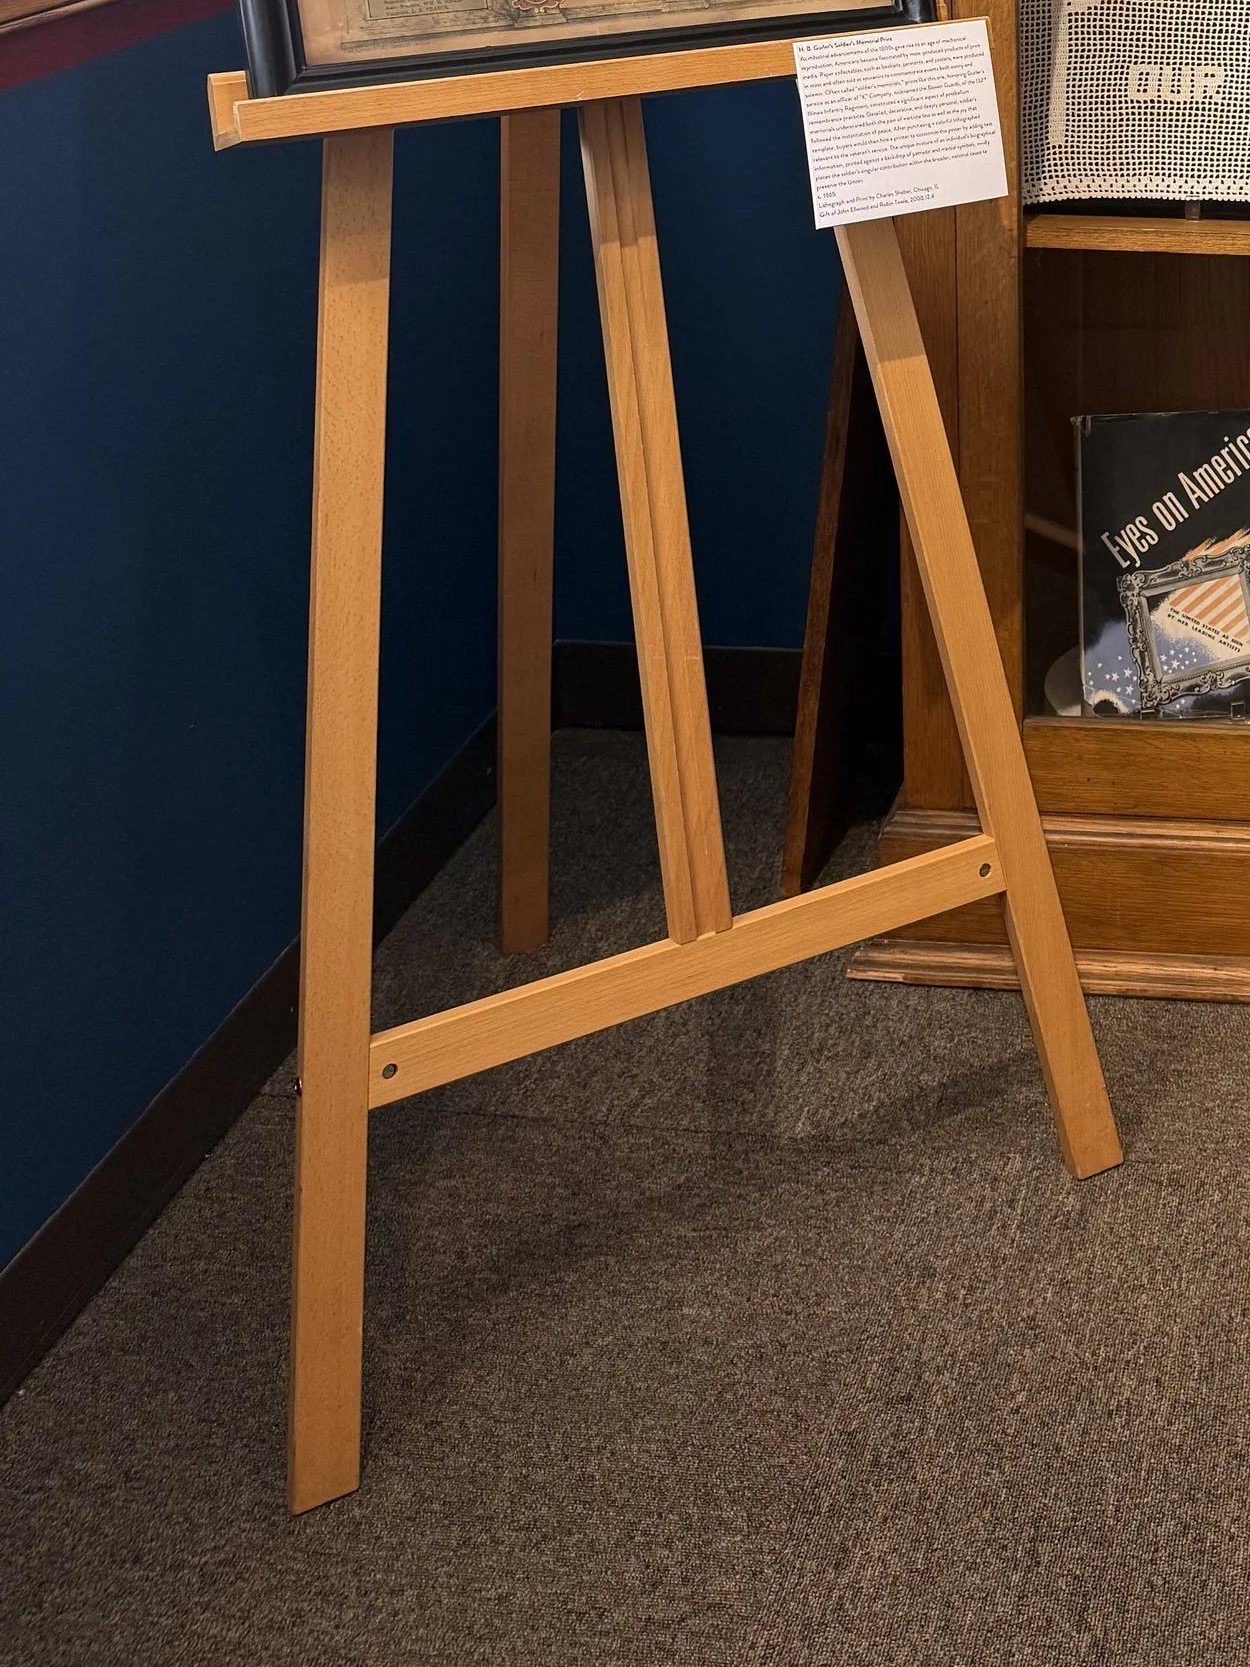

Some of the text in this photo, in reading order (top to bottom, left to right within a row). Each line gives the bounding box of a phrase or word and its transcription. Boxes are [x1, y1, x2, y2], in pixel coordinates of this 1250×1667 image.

[1128, 65, 1224, 100] OUR
[1101, 516, 1159, 569] Eyes
[1152, 491, 1189, 532] on
[1170, 607, 1180, 615] THE
[1181, 613, 1200, 625] UNITED
[1202, 623, 1220, 635] STATES
[1231, 638, 1243, 647] SEEN
[1177, 618, 1189, 626] HER
[1191, 625, 1216, 640] LEADING
[1218, 639, 1241, 653] ARTISTS
